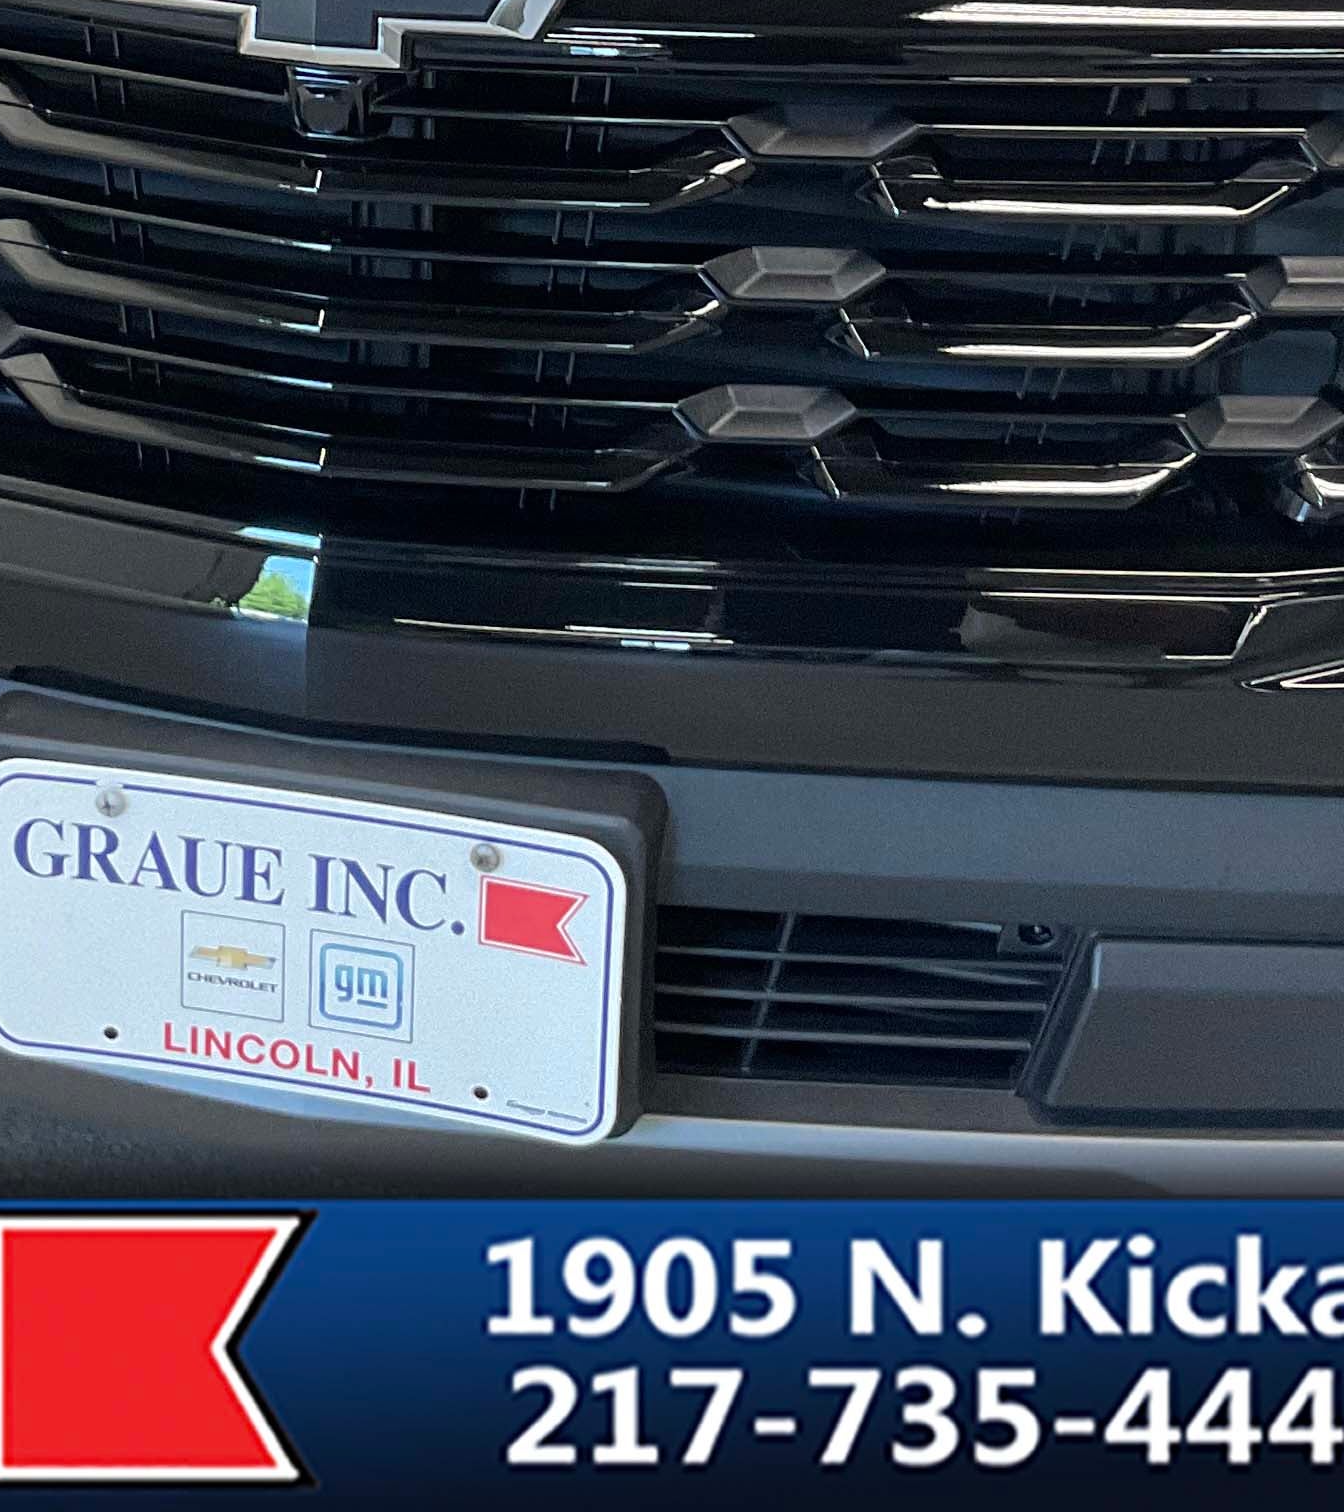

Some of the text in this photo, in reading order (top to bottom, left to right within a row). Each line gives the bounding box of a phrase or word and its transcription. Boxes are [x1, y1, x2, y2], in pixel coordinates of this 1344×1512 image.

[13, 817, 465, 936] GRAUE INC.
[187, 971, 278, 993] CHEVROLET
[334, 963, 389, 1009] gm
[163, 1022, 432, 1093] LINCOLN, IL
